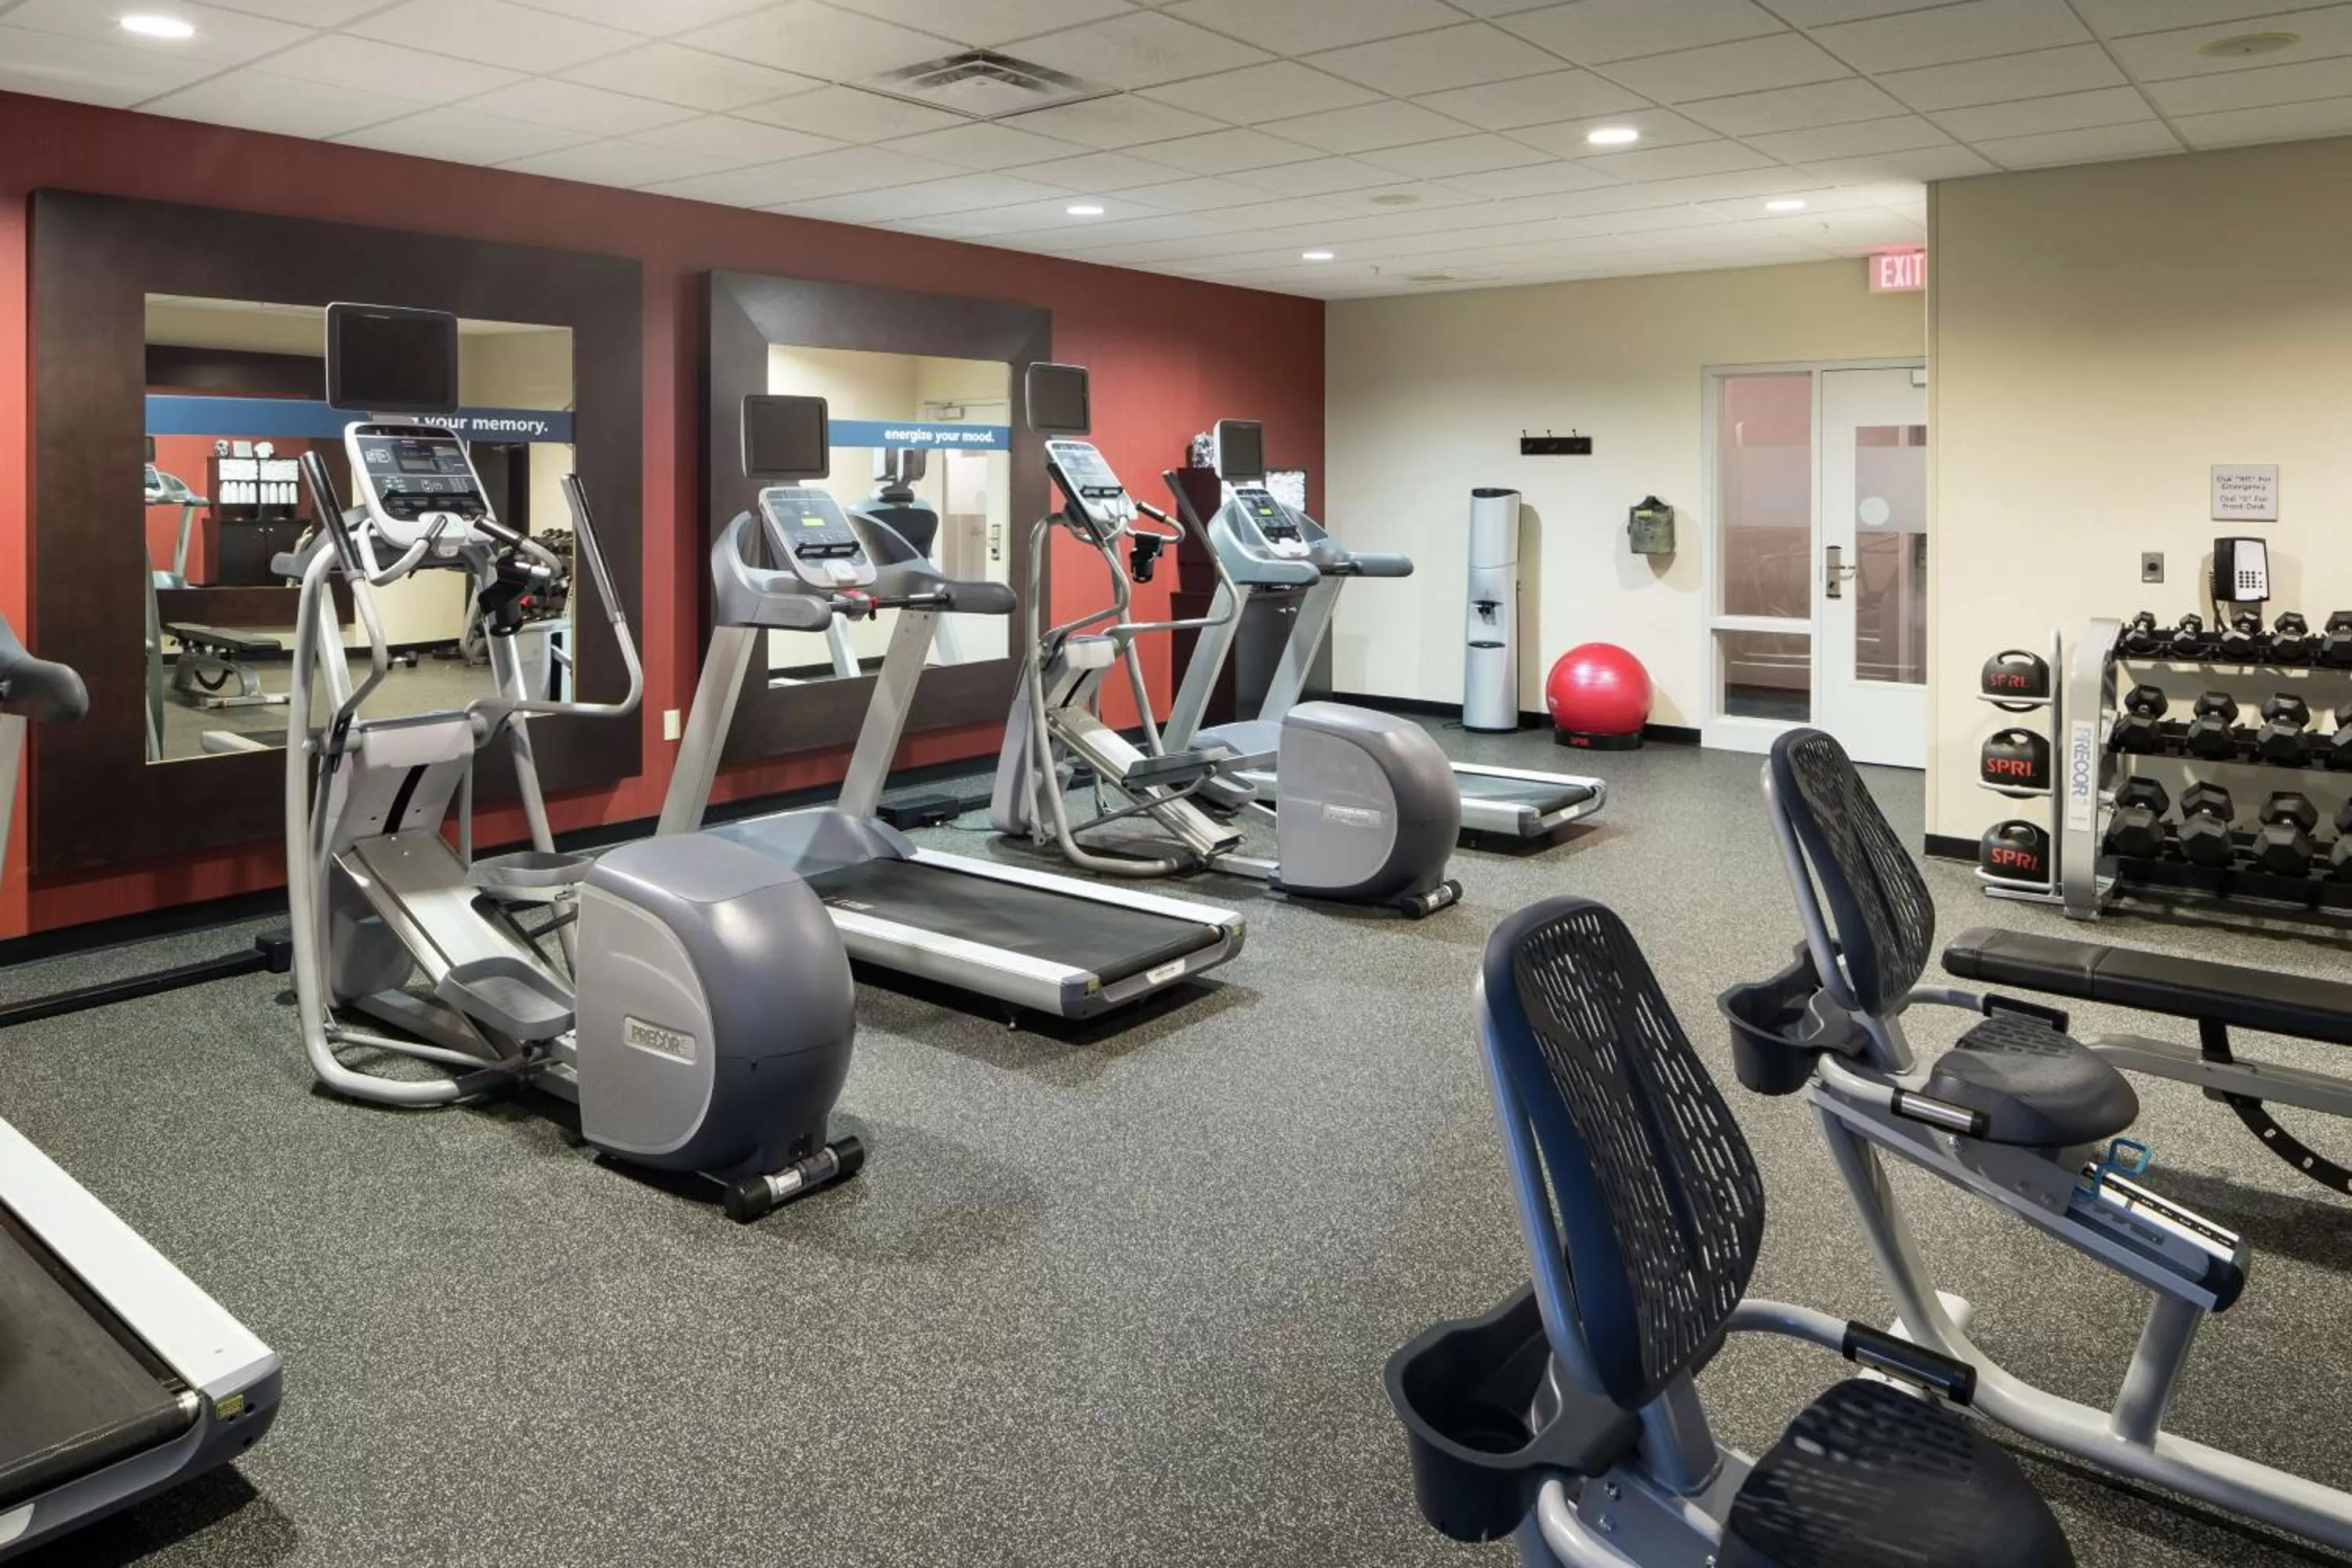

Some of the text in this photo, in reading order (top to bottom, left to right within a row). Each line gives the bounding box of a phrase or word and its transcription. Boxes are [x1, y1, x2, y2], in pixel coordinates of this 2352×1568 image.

[1881, 253, 1924, 289] EXIT
[472, 418, 548, 435] memory.
[884, 429, 995, 444] energize your mood.
[1987, 758, 2032, 777] SPRI
[2072, 727, 2091, 796] PRECOR
[1991, 848, 2038, 871] SPRI
[631, 1025, 680, 1052] PRECOR
